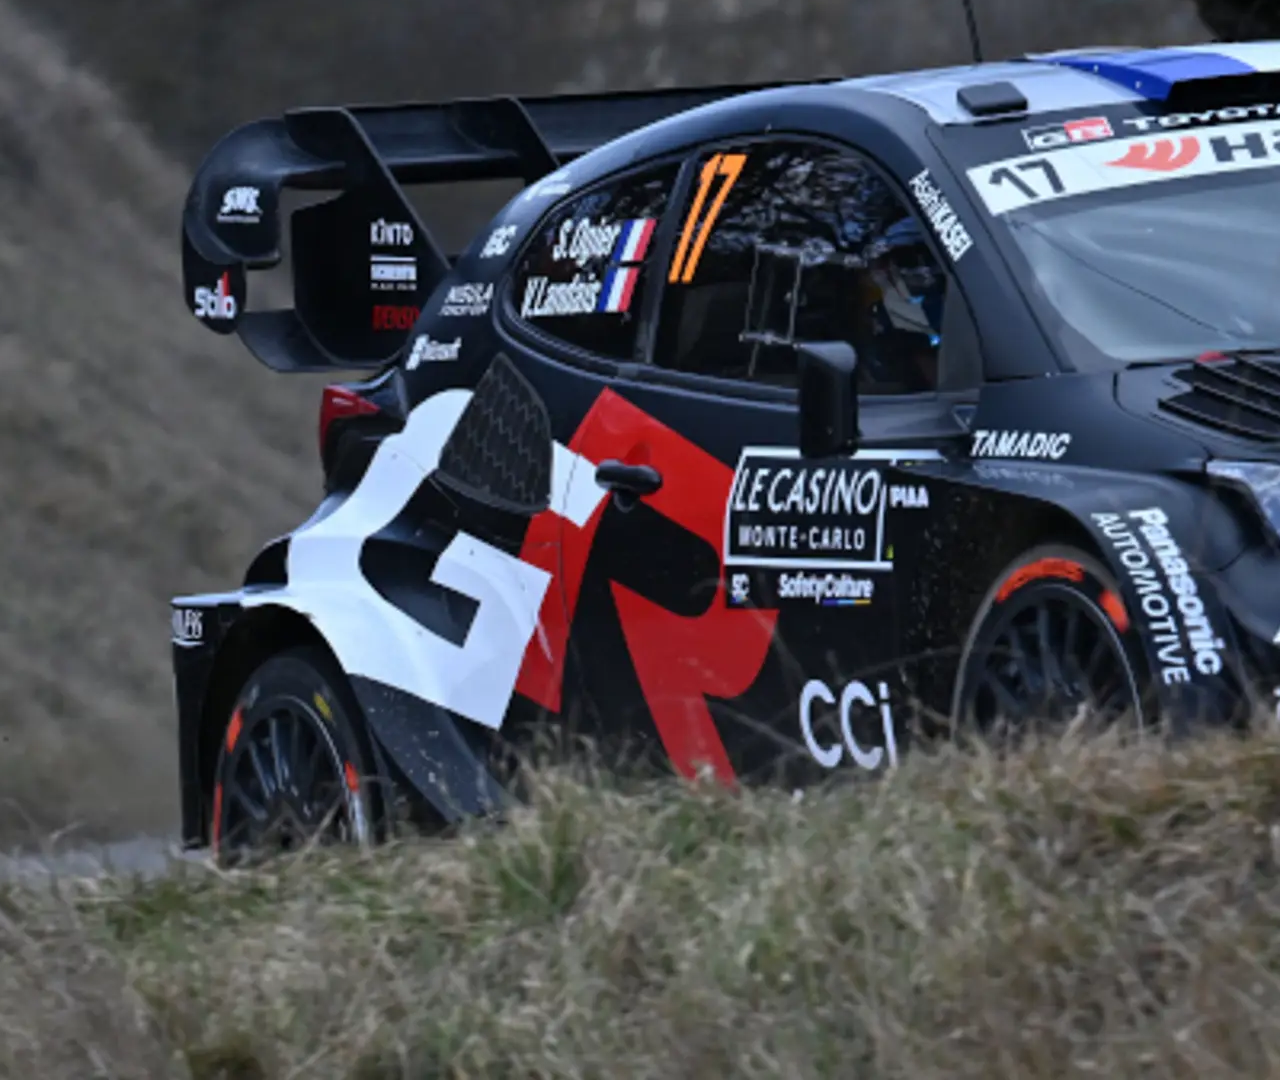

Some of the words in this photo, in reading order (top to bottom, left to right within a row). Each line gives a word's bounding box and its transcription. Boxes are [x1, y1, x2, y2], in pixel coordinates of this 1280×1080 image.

[668, 152, 748, 284] 17
[989, 158, 1066, 201] 17
[970, 429, 1073, 460] TAMADIC
[888, 484, 930, 508] PIAA
[1089, 511, 1193, 685] AUTOMOTIVE
[1127, 505, 1226, 677] Panasonic
